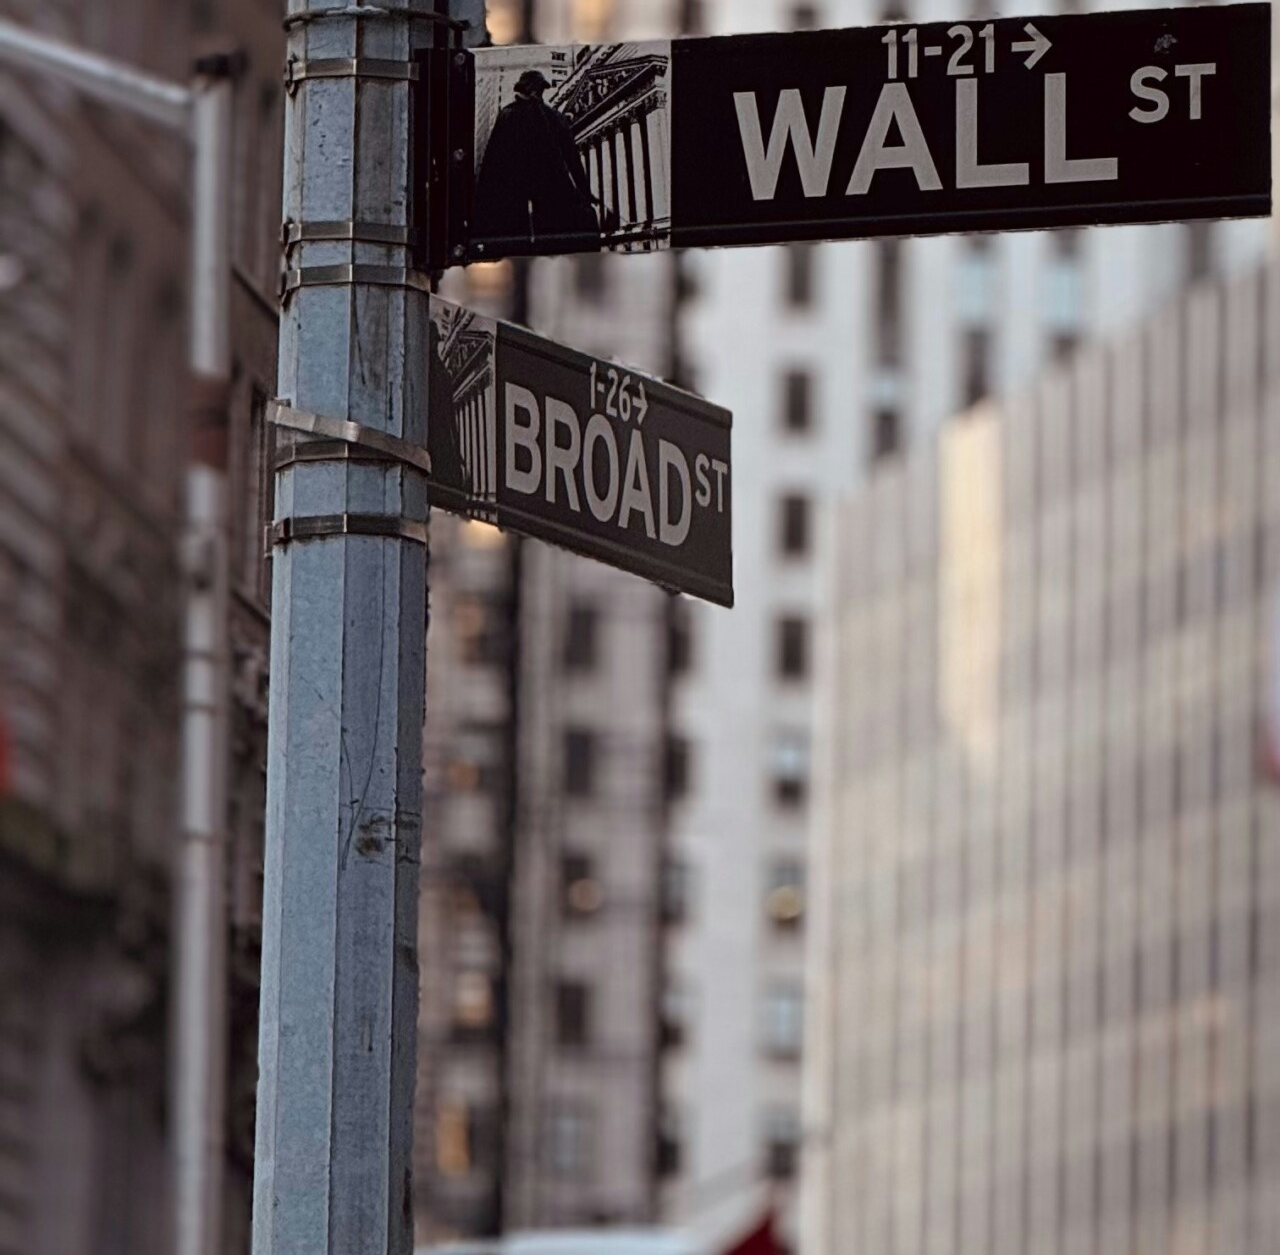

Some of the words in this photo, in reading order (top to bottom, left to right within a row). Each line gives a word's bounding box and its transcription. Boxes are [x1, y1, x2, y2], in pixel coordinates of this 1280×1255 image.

[881, 24, 995, 79] 11-21
[733, 72, 1118, 200] WALL
[1128, 63, 1216, 123] ST
[590, 361, 631, 422] 1-26
[505, 382, 692, 547] BROAD
[695, 453, 729, 513] ST
